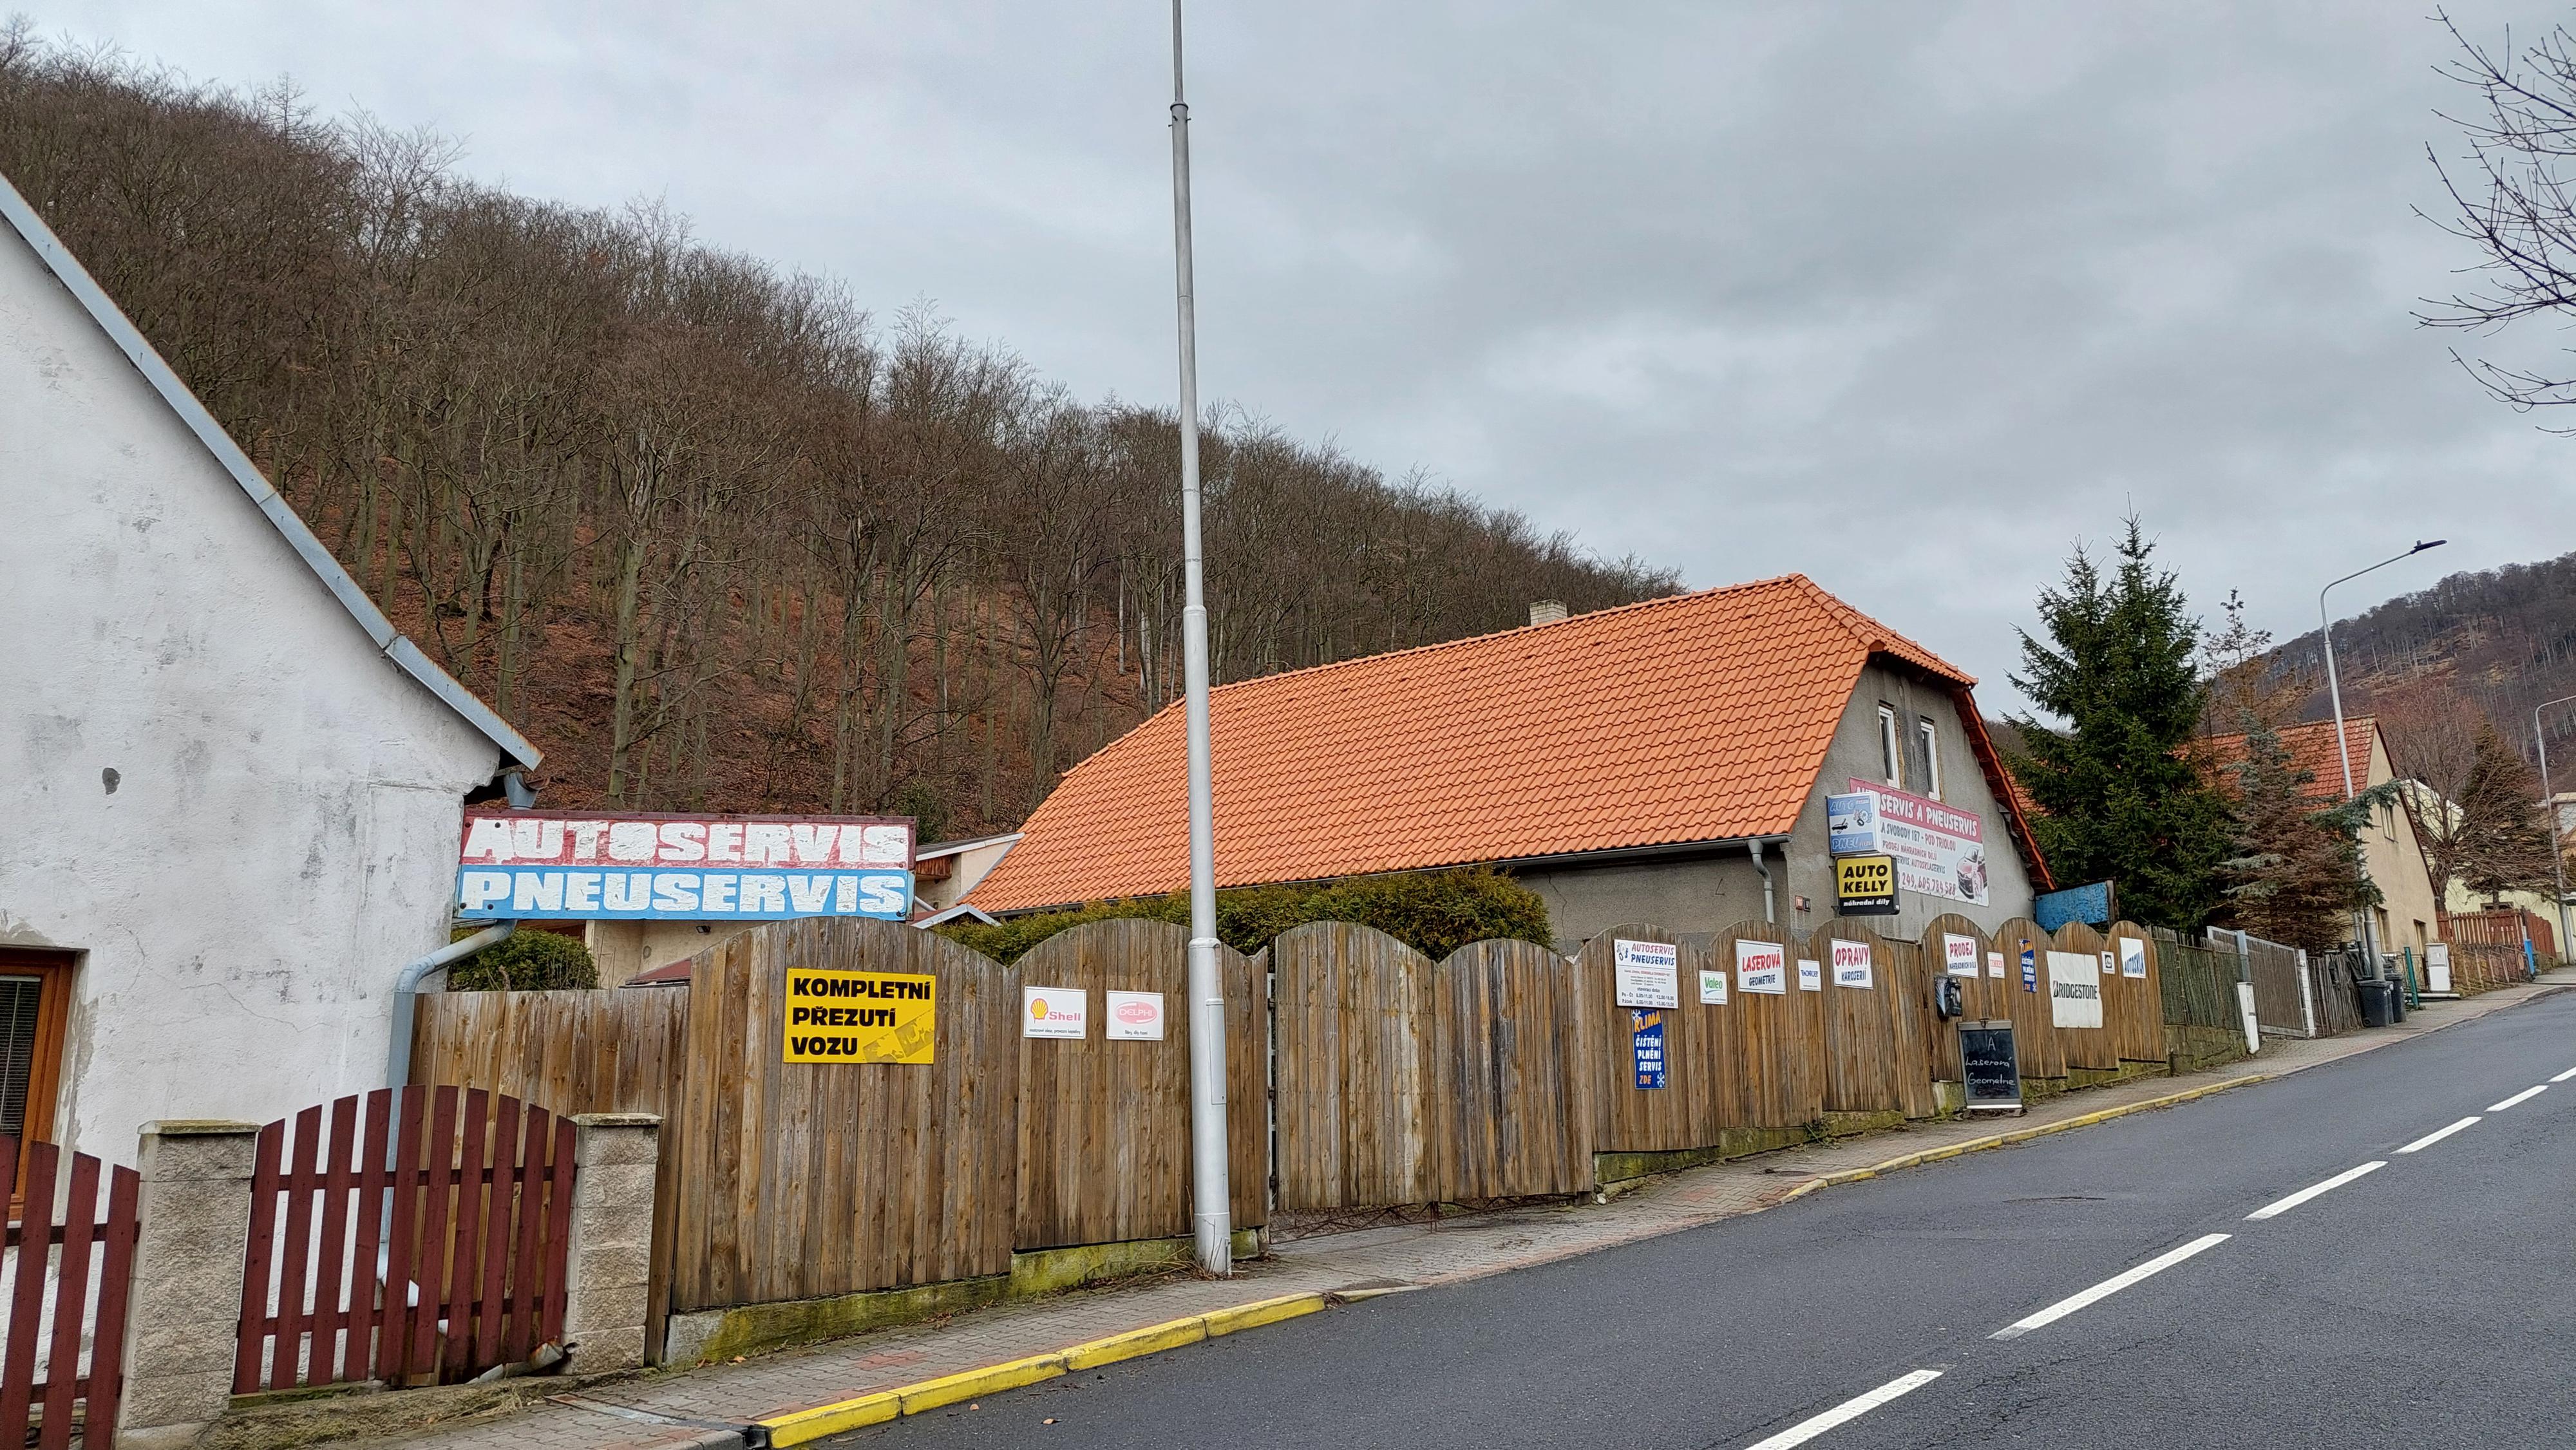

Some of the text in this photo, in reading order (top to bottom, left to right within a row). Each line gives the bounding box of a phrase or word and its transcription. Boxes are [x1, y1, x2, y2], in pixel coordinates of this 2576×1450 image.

[1830, 800, 1853, 812] AUTO
[1916, 804, 1923, 822] A
[1926, 807, 1977, 837] PNEUSERVIS
[1887, 824, 1910, 840] SVOBODY
[463, 818, 907, 864] AUTOSERVIS
[1882, 840, 1899, 851] PRODEJ
[1843, 865, 1888, 878] AUTO
[1844, 880, 1888, 893] KELLY
[1918, 876, 1930, 890] 605
[461, 871, 907, 916] PNEUSERVIS
[1632, 943, 1674, 956] AUTOSERVIS
[1949, 942, 1973, 957] PRODEJ
[1631, 954, 1674, 966] PNEUSERVIS
[1742, 950, 1781, 972] LASEROVÁ
[1835, 947, 1868, 967] OPRAVY
[2125, 950, 2145, 974] AUTOSKLA
[1705, 977, 1723, 990] Valeo
[1748, 974, 1776, 986] GEOMETRIE
[793, 977, 931, 1000] KOMPLETNÍ
[2053, 980, 2098, 1000] BRIDGESTONE
[792, 1006, 896, 1027] PŘEZUTÍ
[1049, 1012, 1081, 1022] Shell
[1119, 1008, 1152, 1017] DELPHI
[1634, 1010, 1661, 1033] KLIMA
[791, 1037, 858, 1055] VOZU
[1636, 1035, 1662, 1047] ČIŠTĚNÍ
[1639, 1061, 1662, 1071] SERVIS
[1639, 1075, 1652, 1084] ZDE
[1967, 1072, 2016, 1085] Geometrie
